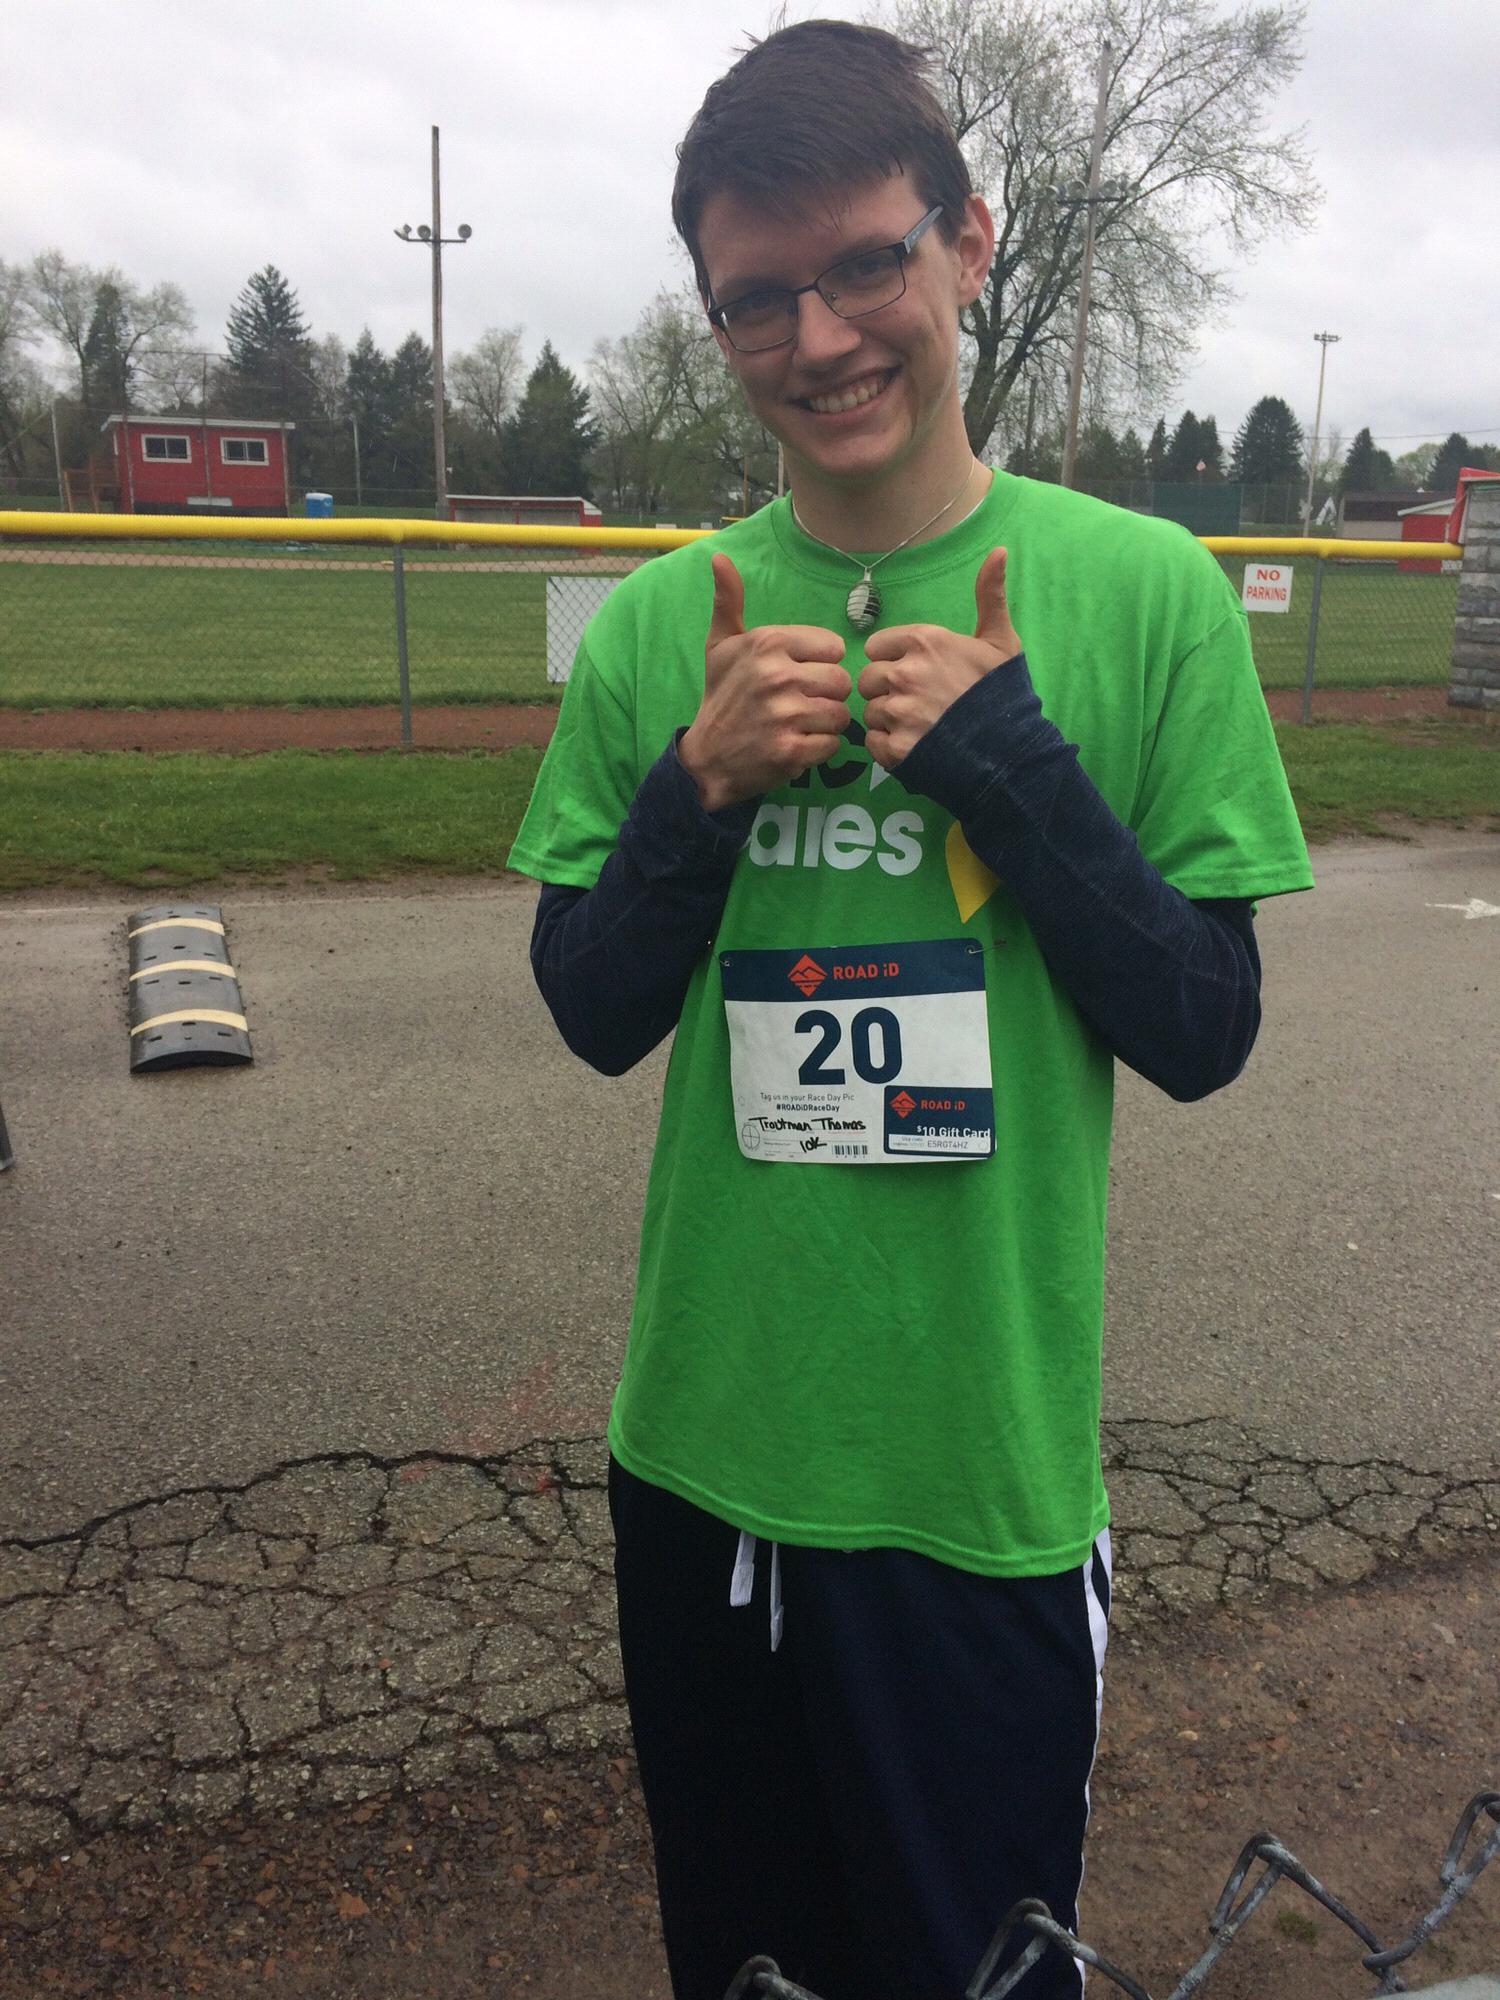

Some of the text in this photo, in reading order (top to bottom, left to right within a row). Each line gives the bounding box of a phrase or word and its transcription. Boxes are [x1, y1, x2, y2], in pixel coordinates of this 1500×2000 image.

[1257, 569, 1281, 581] NO
[1246, 586, 1287, 601] PARKING
[833, 964, 878, 980] ROAD
[794, 1006, 903, 1086] 20
[760, 1092, 771, 1102] Tag
[807, 1093, 825, 1101] Race
[827, 1093, 841, 1102] Day
[843, 1093, 855, 1101] Pic
[921, 1100, 951, 1111] ROAD
[811, 1117, 866, 1130] Thomas
[917, 1125, 991, 1138] $10 Gift Card
[800, 1136, 828, 1153] 10K
